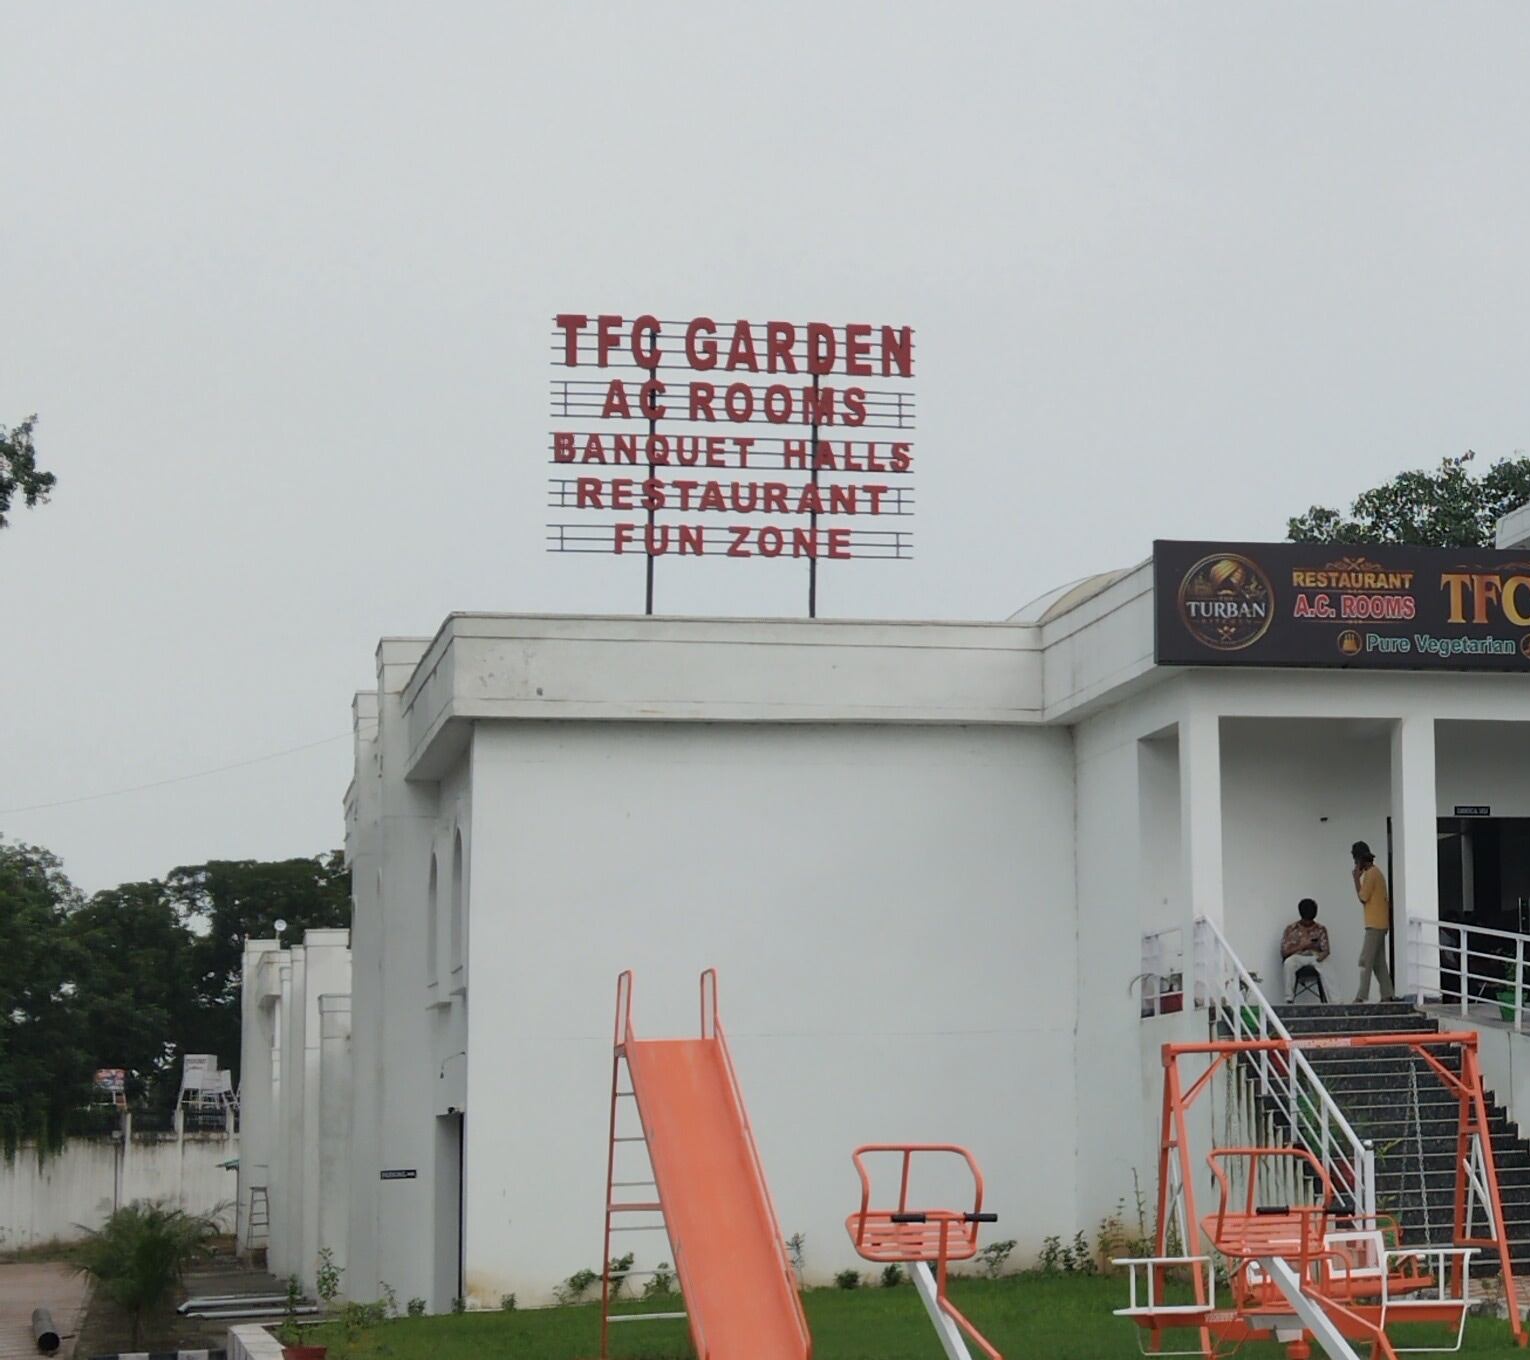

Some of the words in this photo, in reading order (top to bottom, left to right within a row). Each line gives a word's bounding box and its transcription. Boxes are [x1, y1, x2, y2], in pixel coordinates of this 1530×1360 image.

[557, 314, 662, 368] TFC
[686, 317, 912, 376] GARDEN
[602, 379, 667, 420] AC
[689, 381, 867, 426] ROOMS
[554, 432, 755, 466] BANQUET
[784, 439, 912, 472] HALLS
[577, 477, 889, 514] RESTAURANT
[614, 523, 704, 556] FUN
[728, 526, 852, 559] ZONE
[1292, 571, 1414, 589] RESTAURANT
[1186, 601, 1266, 619] TURBAN
[1293, 594, 1336, 618] A.C.
[1341, 595, 1416, 620] ROOMS
[1366, 633, 1411, 654] Pure
[1414, 634, 1516, 658] Vegetarian
